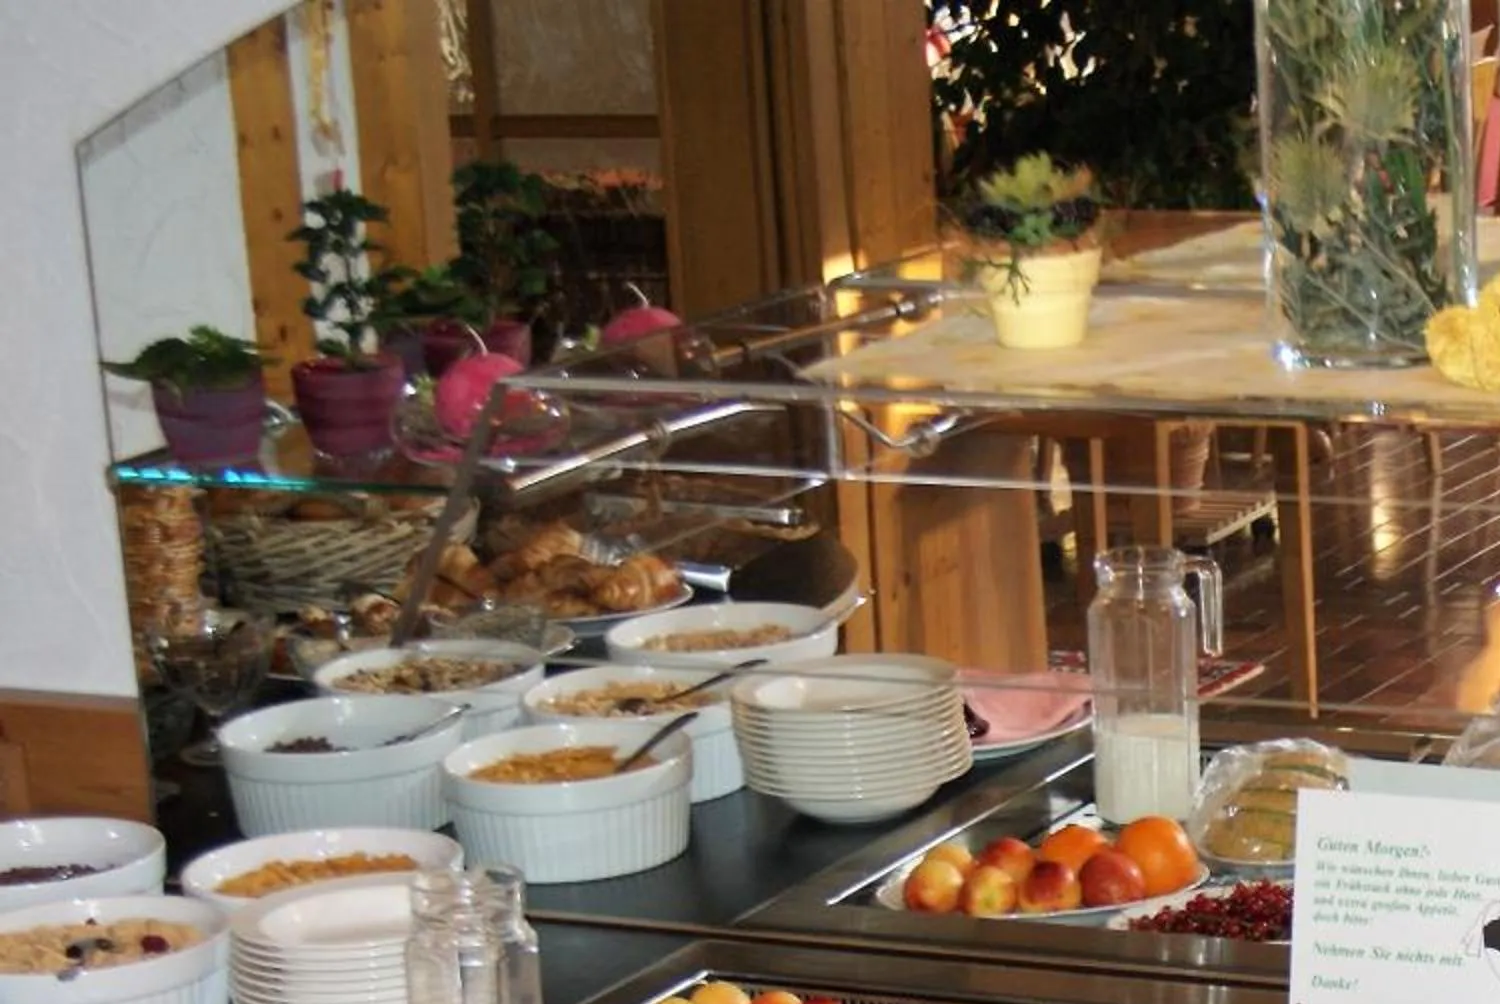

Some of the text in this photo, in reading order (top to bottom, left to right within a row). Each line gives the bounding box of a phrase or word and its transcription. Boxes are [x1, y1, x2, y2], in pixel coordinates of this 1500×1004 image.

[1317, 837, 1359, 853] Guten
[1313, 941, 1365, 957] Nehmen
[1370, 945, 1392, 960] Sie
[1395, 950, 1435, 964] nichts
[1310, 975, 1359, 990] Danke!
